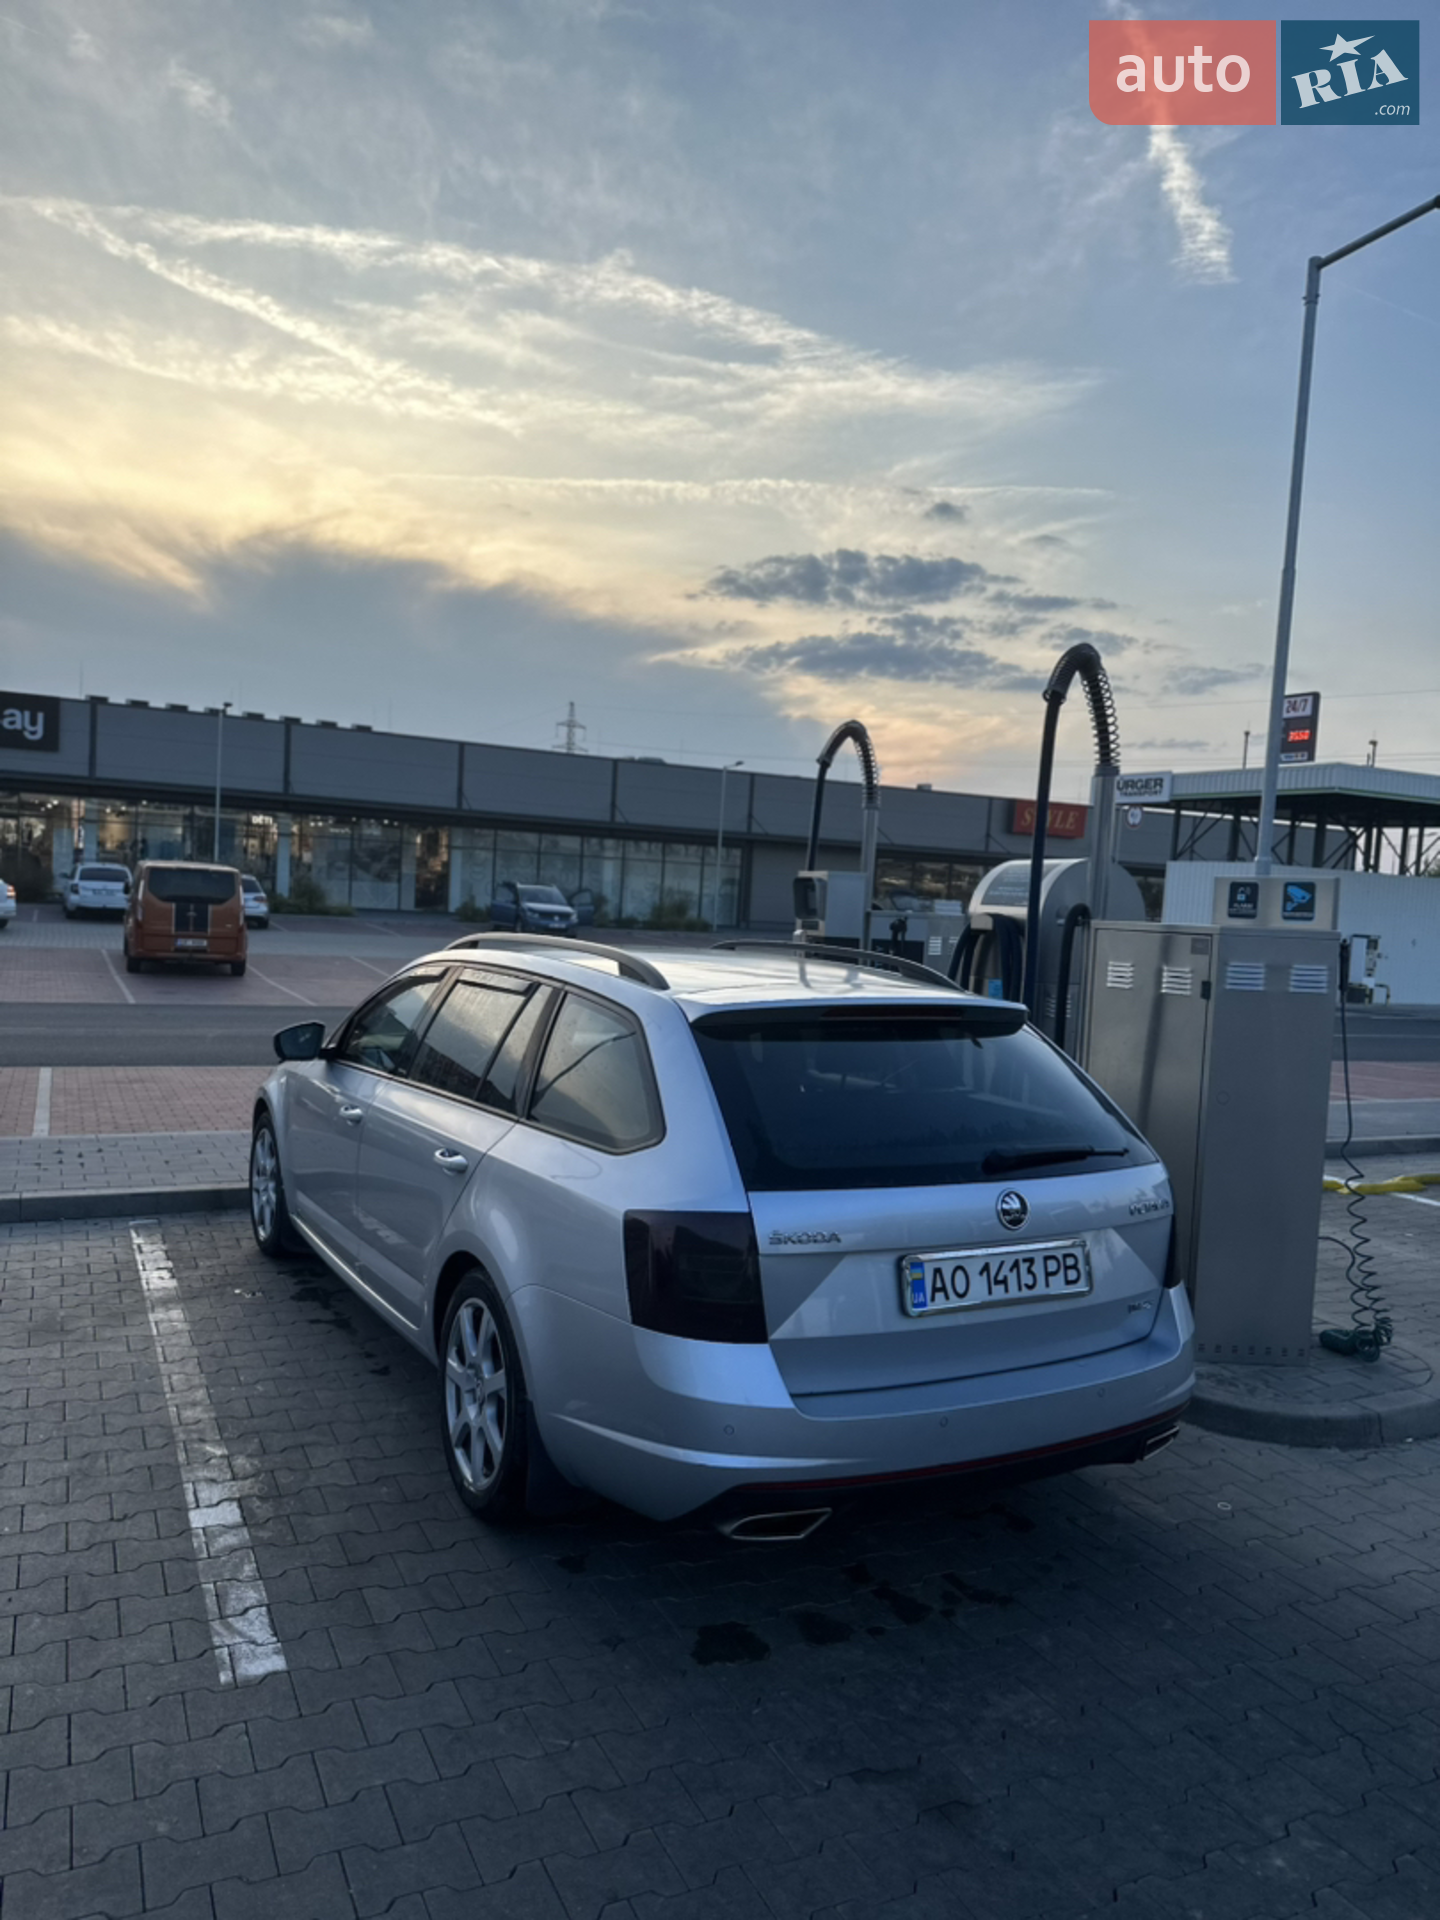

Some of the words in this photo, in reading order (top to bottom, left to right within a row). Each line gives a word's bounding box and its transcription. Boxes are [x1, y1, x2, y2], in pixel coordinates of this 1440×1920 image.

[1286, 698, 1309, 714] 24/7
[0, 708, 44, 740] ay
[1021, 806, 1079, 831] SYLE
[930, 1264, 970, 1303] AO
[978, 1257, 1037, 1296] 1413
[1043, 1252, 1082, 1288] PB
